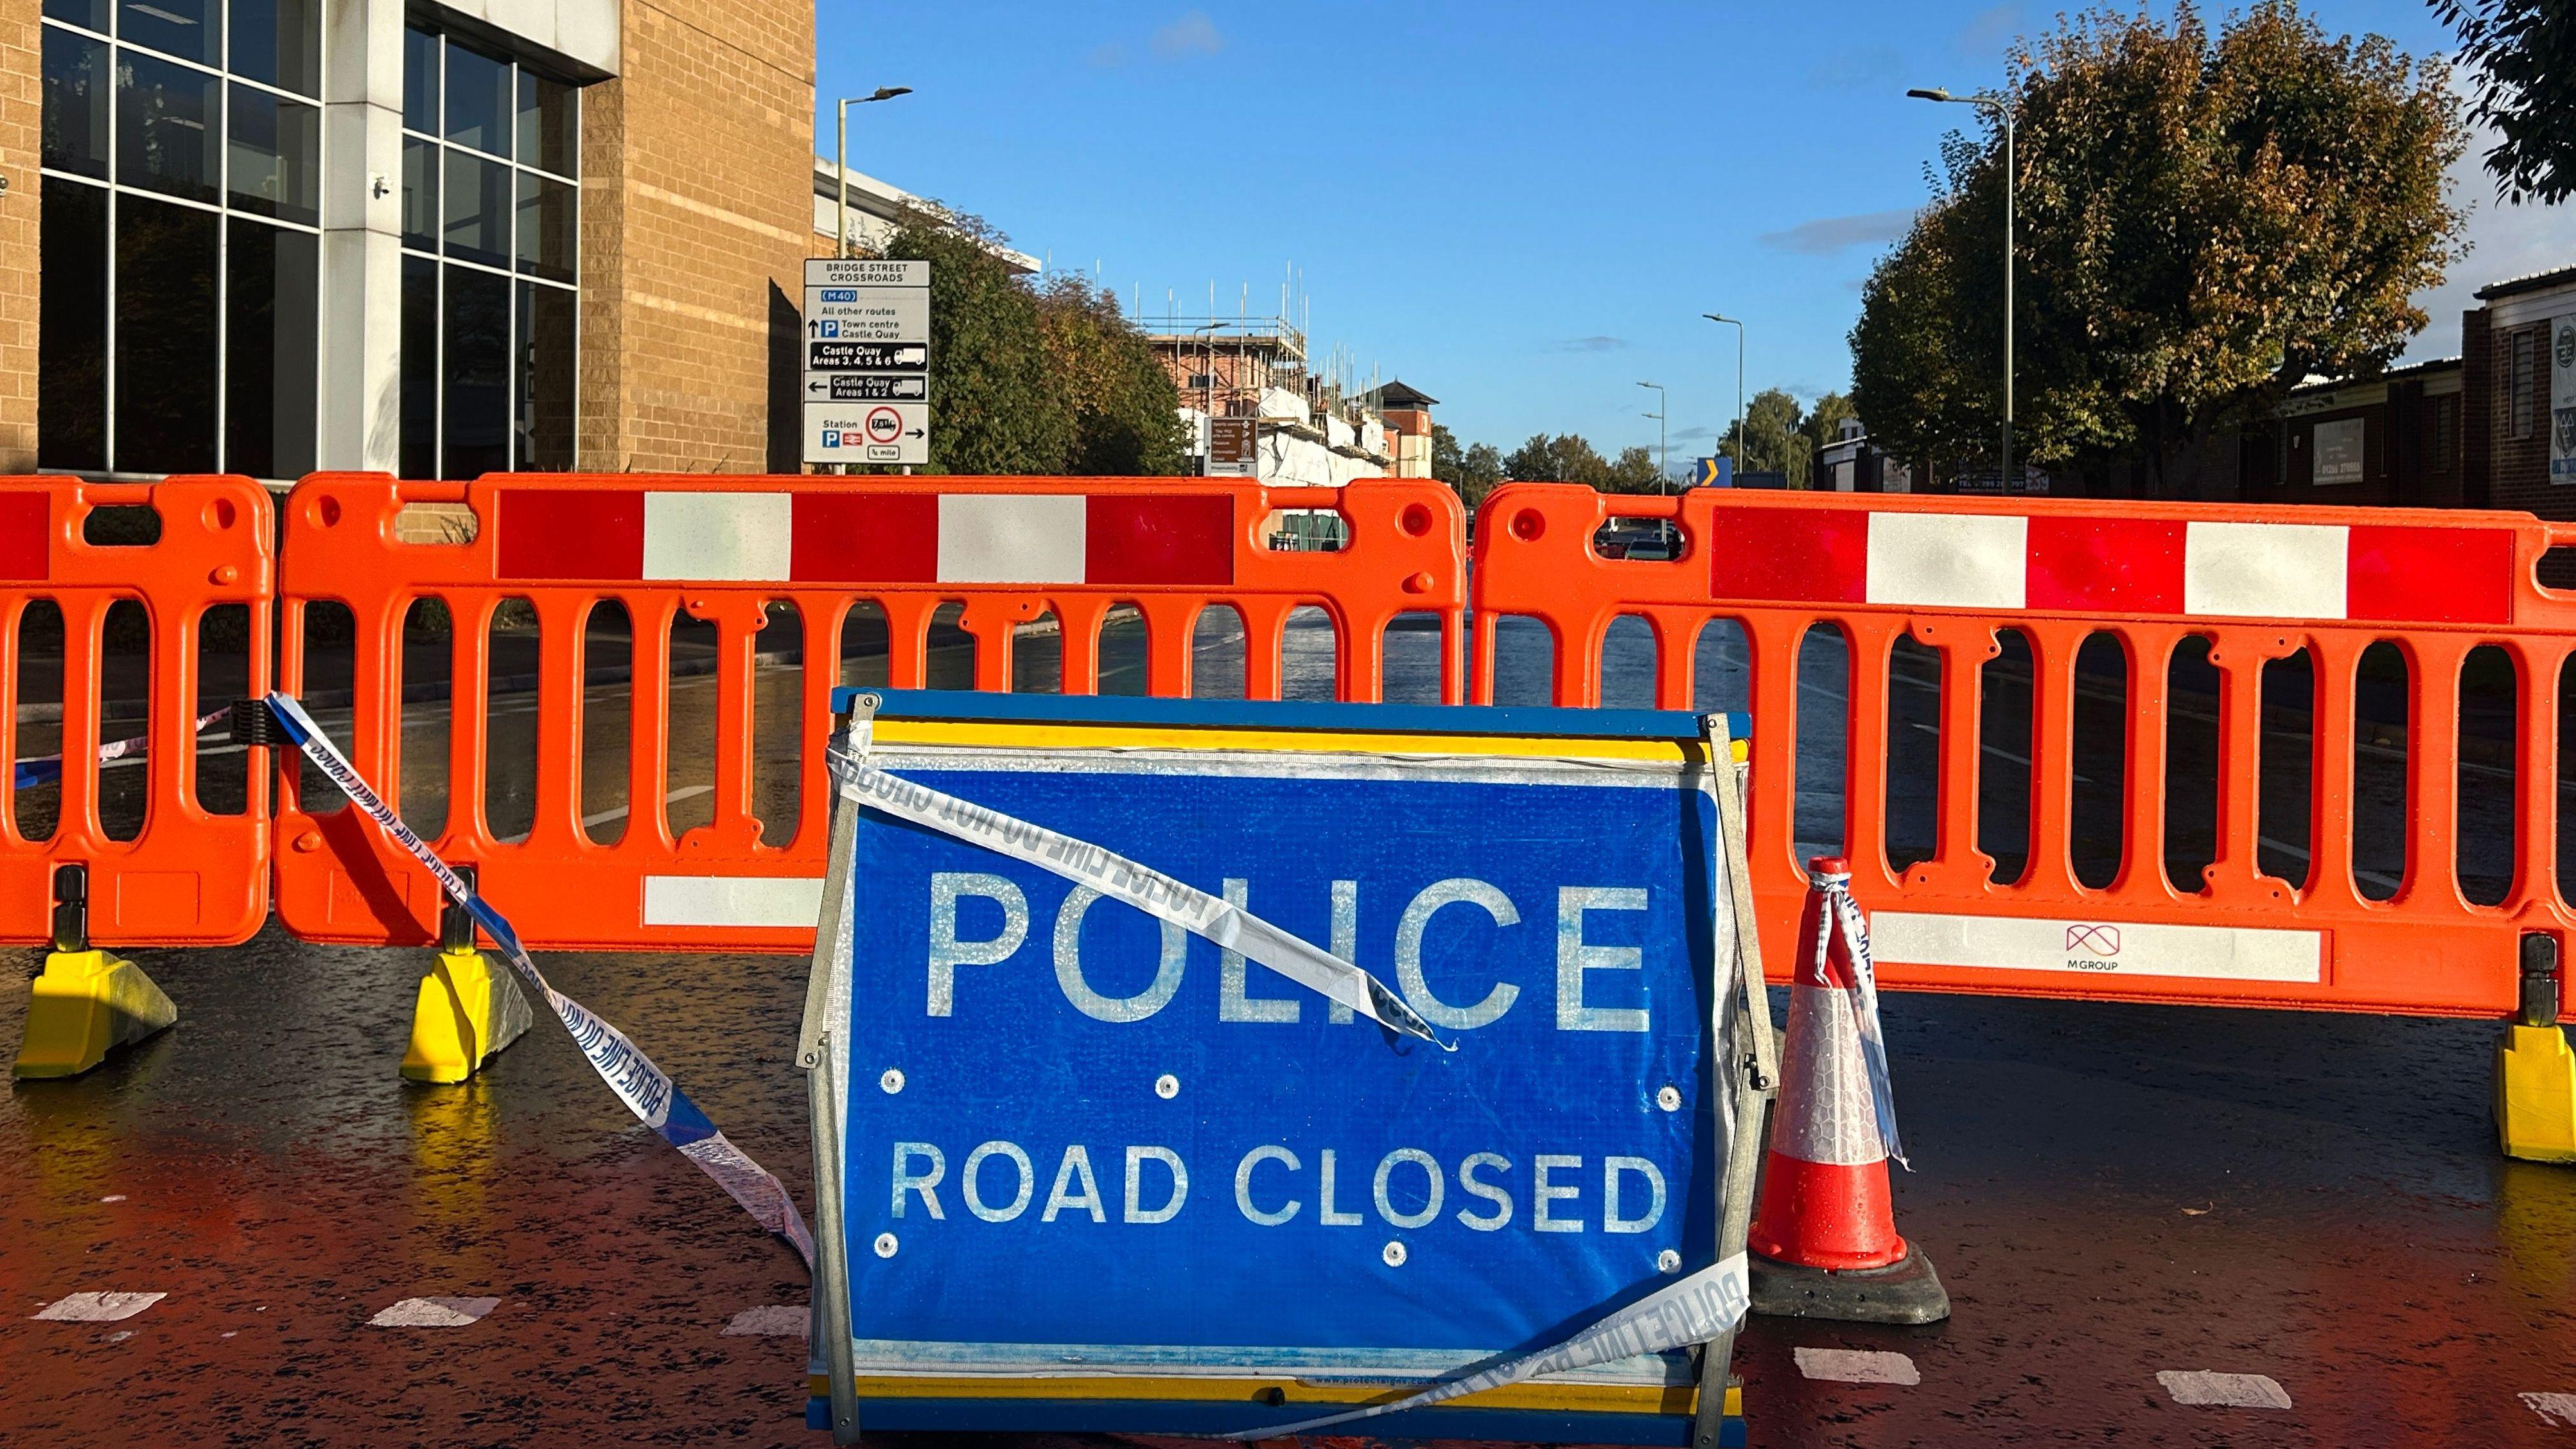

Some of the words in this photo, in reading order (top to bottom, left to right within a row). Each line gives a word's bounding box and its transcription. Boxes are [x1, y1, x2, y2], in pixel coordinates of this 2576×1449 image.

[826, 263, 865, 272] BRIDGE
[868, 264, 908, 272] STREET
[830, 273, 904, 282] CROSSROADS
[822, 292, 856, 301] (M40)
[821, 306, 834, 315] All
[837, 307, 863, 315] other
[866, 308, 896, 316] routes
[841, 321, 866, 329] Town
[841, 330, 872, 338] Castle
[875, 330, 900, 339] Quay
[822, 346, 854, 356] Castle
[856, 346, 882, 357] Quay
[812, 356, 839, 365] Areas
[833, 377, 864, 387] Castle
[866, 377, 891, 388] Quay
[836, 388, 863, 397] Areas
[823, 419, 858, 429] Station
[927, 872, 1650, 1032] POLICE
[891, 1141, 1189, 1224] ROAD
[1234, 1145, 1667, 1234] CLOSED
